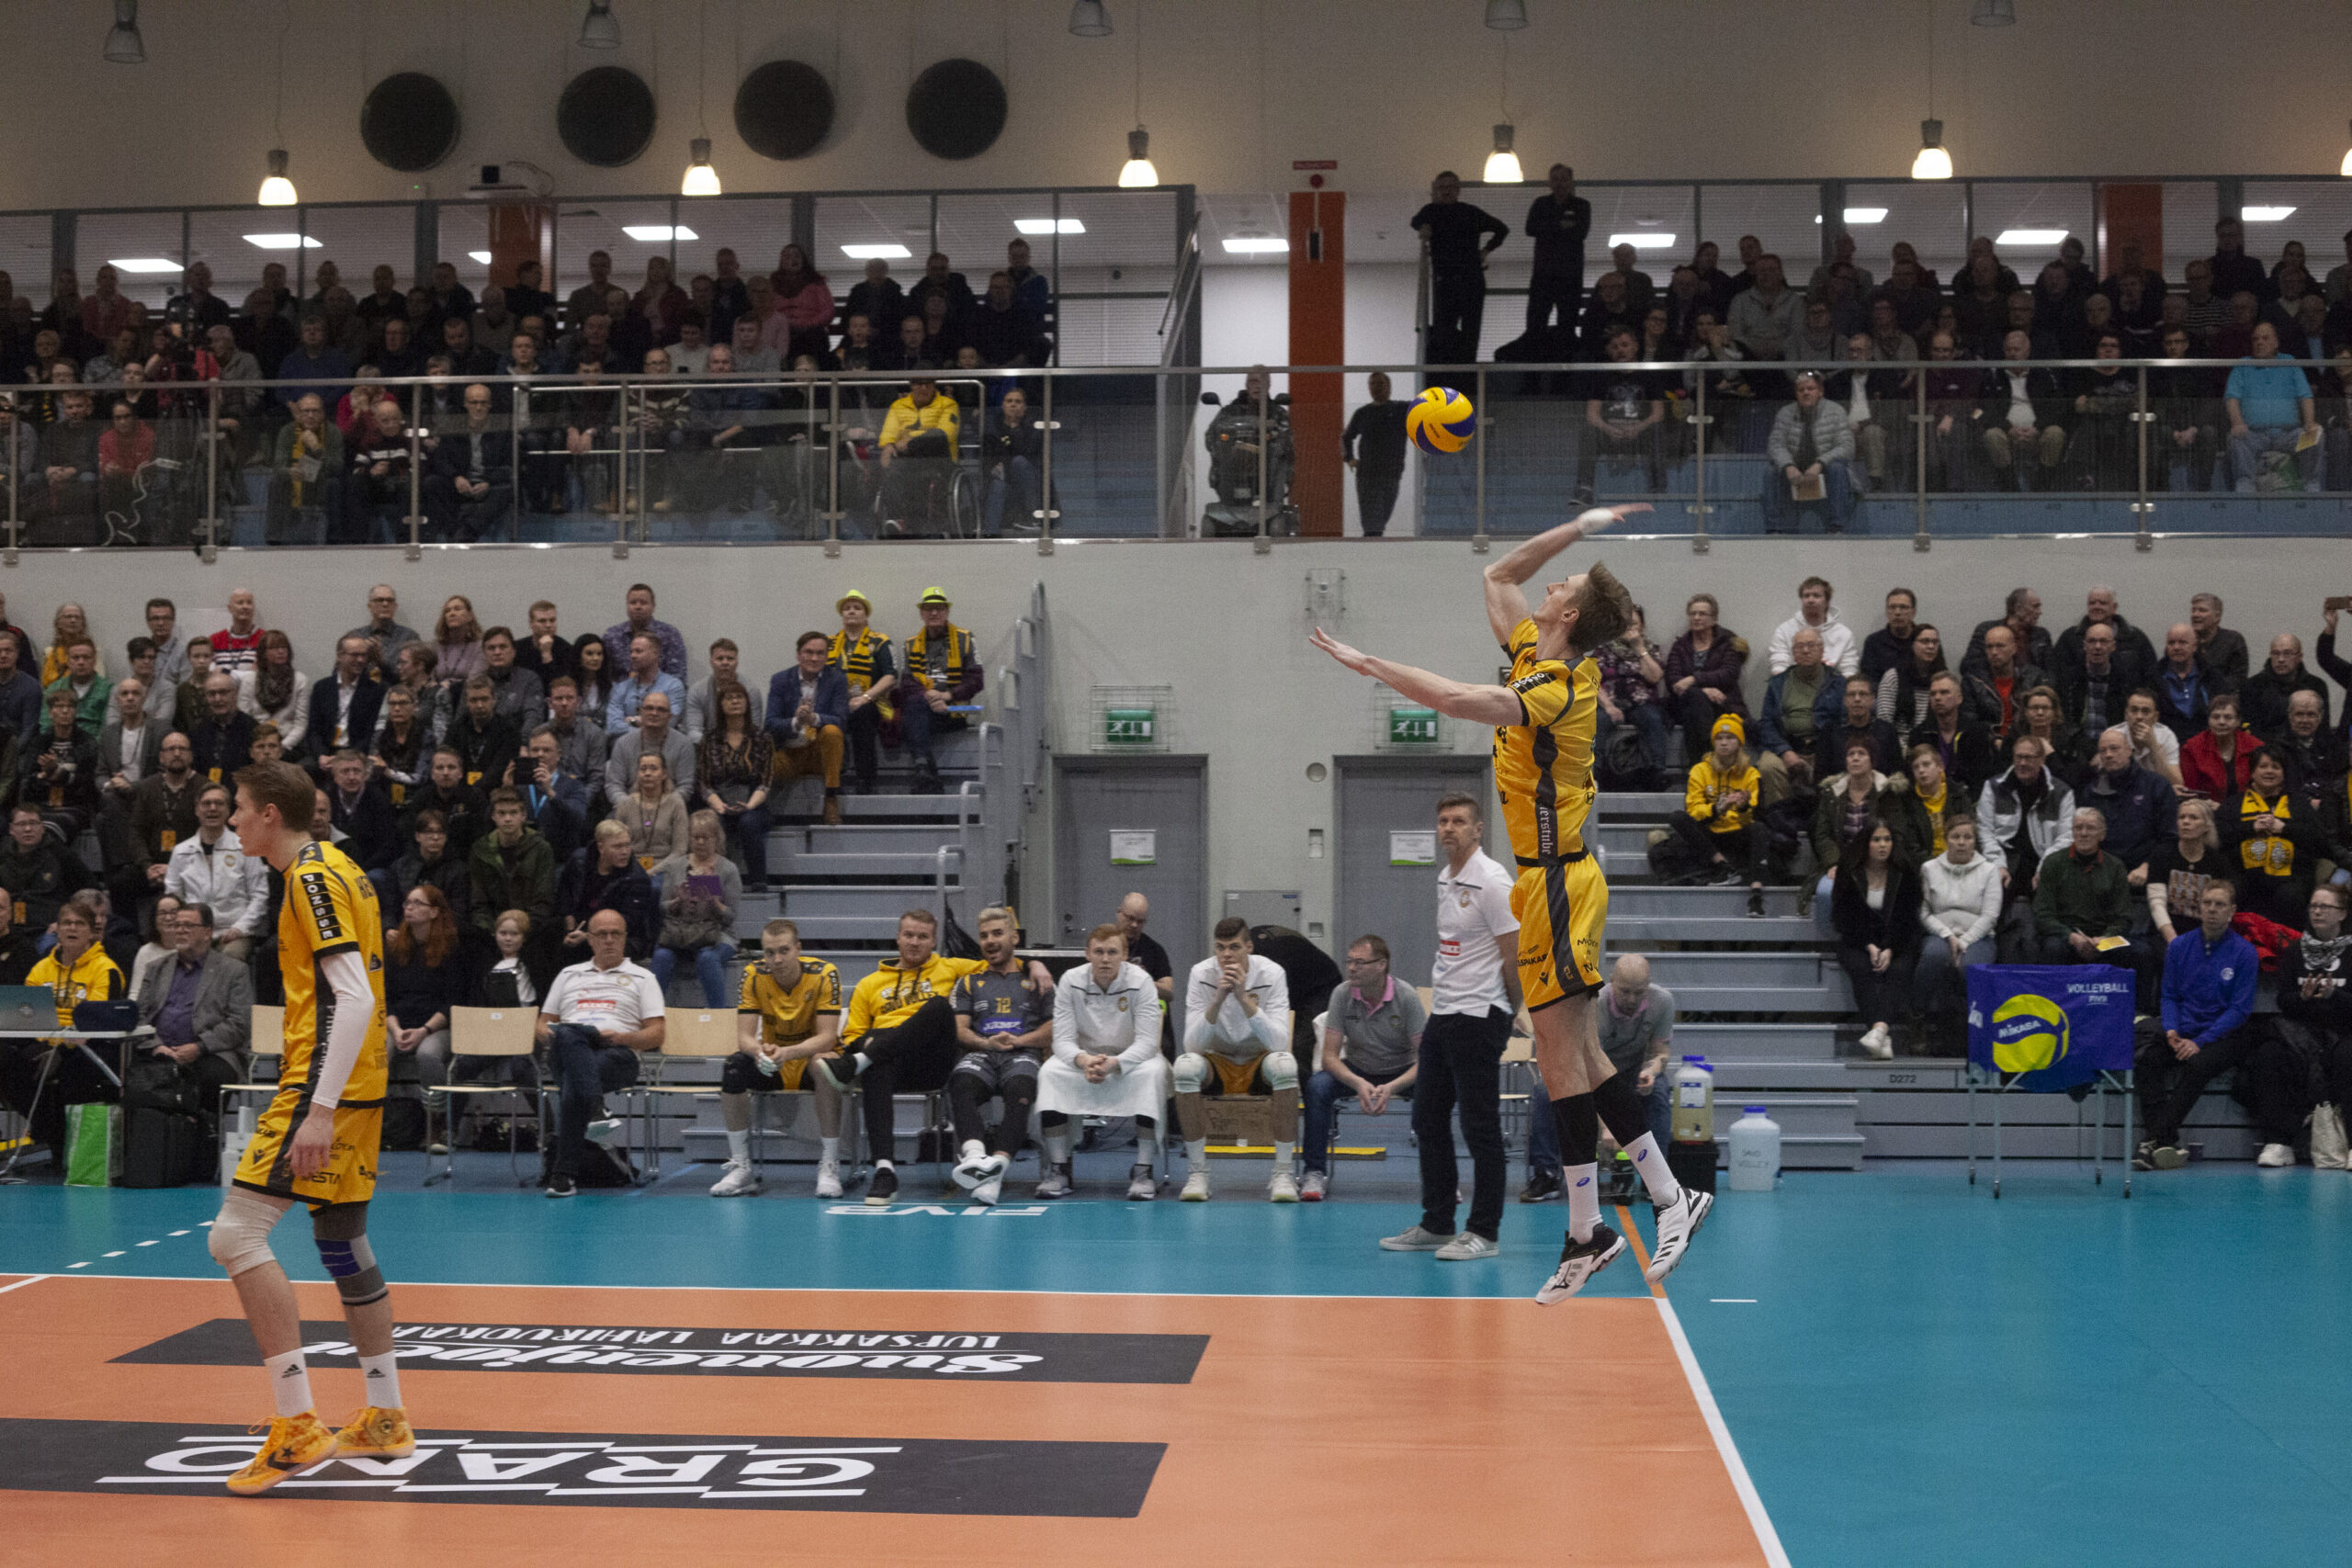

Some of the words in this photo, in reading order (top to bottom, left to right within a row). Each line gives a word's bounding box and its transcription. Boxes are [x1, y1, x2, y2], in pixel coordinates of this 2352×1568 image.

[302, 874, 334, 939] PONSSE
[2067, 983, 2129, 993] VOLLEYBALL
[995, 998, 1011, 1013] 12
[721, 1332, 1001, 1348] LUPSAKKAA
